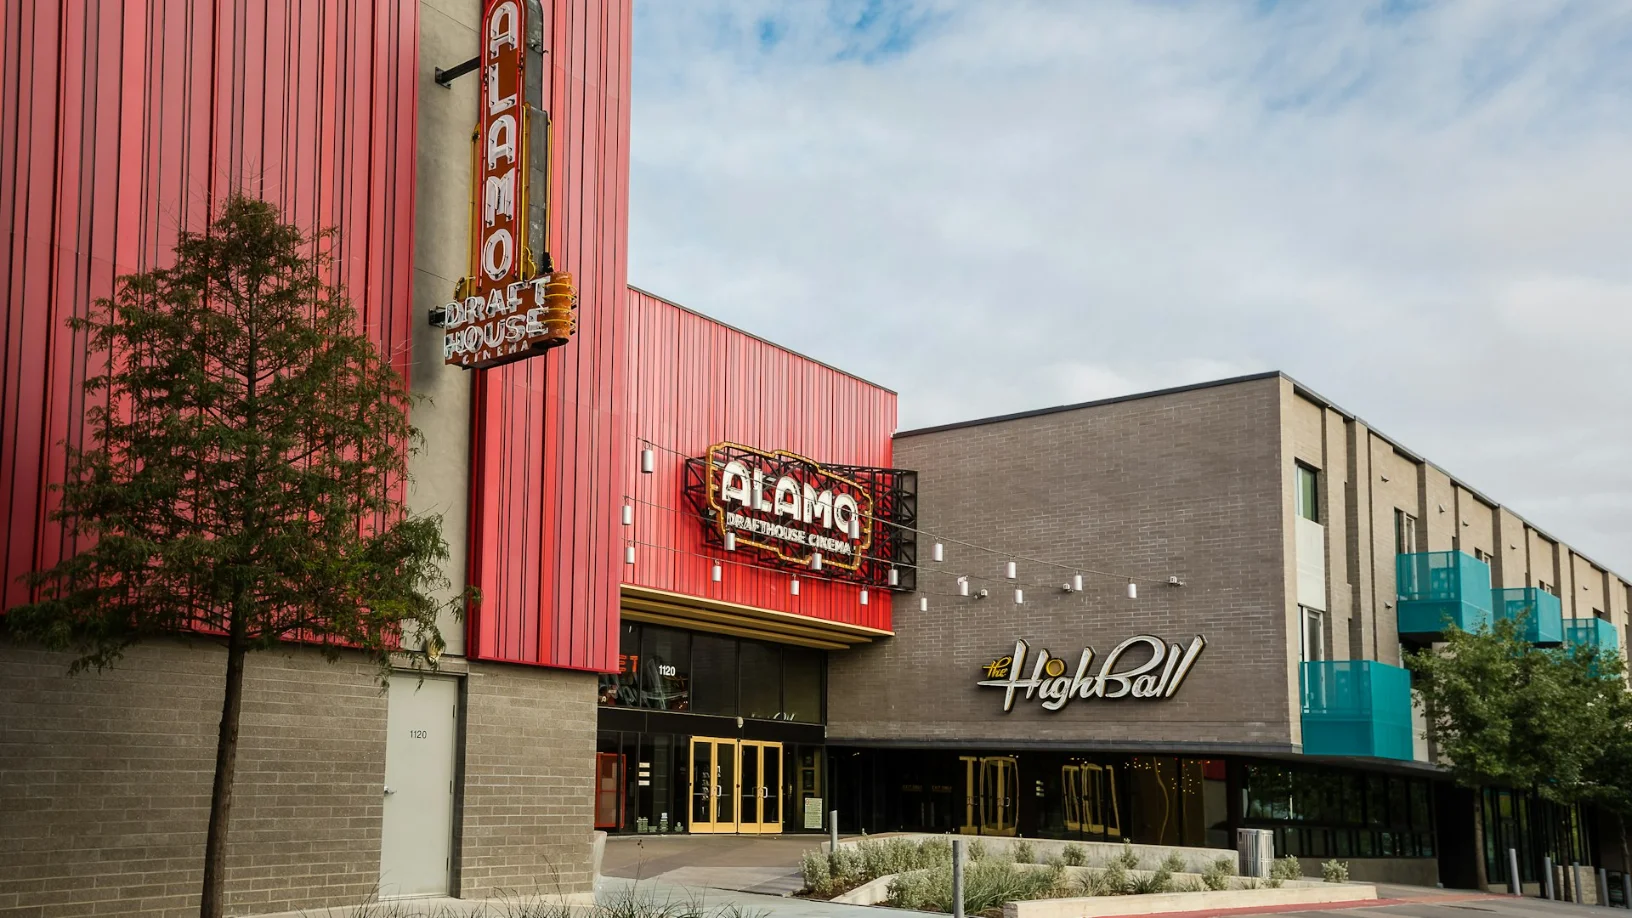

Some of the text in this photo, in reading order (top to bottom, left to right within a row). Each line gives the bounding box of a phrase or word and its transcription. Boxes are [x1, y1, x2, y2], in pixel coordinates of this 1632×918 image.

[483, 2, 518, 281] ALAMO
[445, 276, 551, 328] DRAFT
[444, 308, 549, 360] HOUSE
[462, 340, 529, 365] CINEMA
[722, 461, 859, 534] ALAMO
[726, 511, 852, 556] DRAFTHOUSE CINEMA
[659, 665, 676, 676] 1120
[977, 635, 1205, 712] the HighBall
[410, 730, 427, 739] 1120
